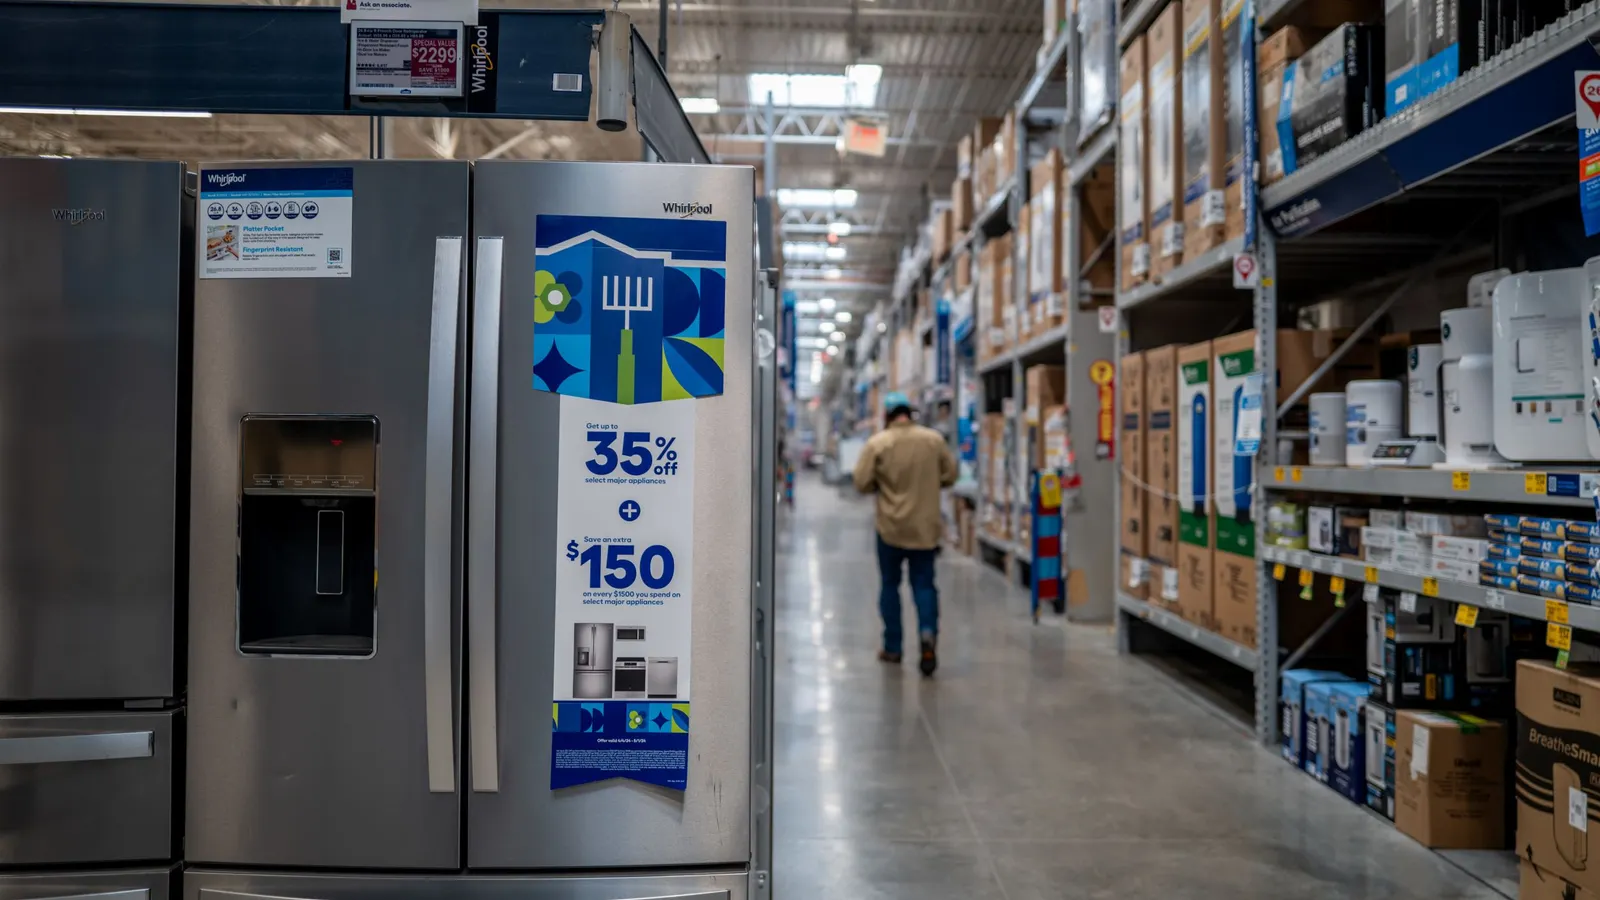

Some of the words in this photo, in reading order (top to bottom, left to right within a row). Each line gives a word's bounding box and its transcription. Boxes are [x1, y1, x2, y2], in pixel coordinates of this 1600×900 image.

[412, 47, 456, 63] $2299
[471, 25, 493, 93] Whirlpool
[208, 173, 246, 186] Whirlpool
[52, 208, 105, 226] Whirlpool
[662, 202, 712, 218] Whirlpool
[585, 431, 678, 476] 35%
[654, 462, 678, 476] off
[607, 477, 628, 485] major
[628, 477, 666, 485] appliances
[1542, 542, 1552, 552] A2
[1588, 547, 1600, 558] A2
[566, 540, 675, 590] $150
